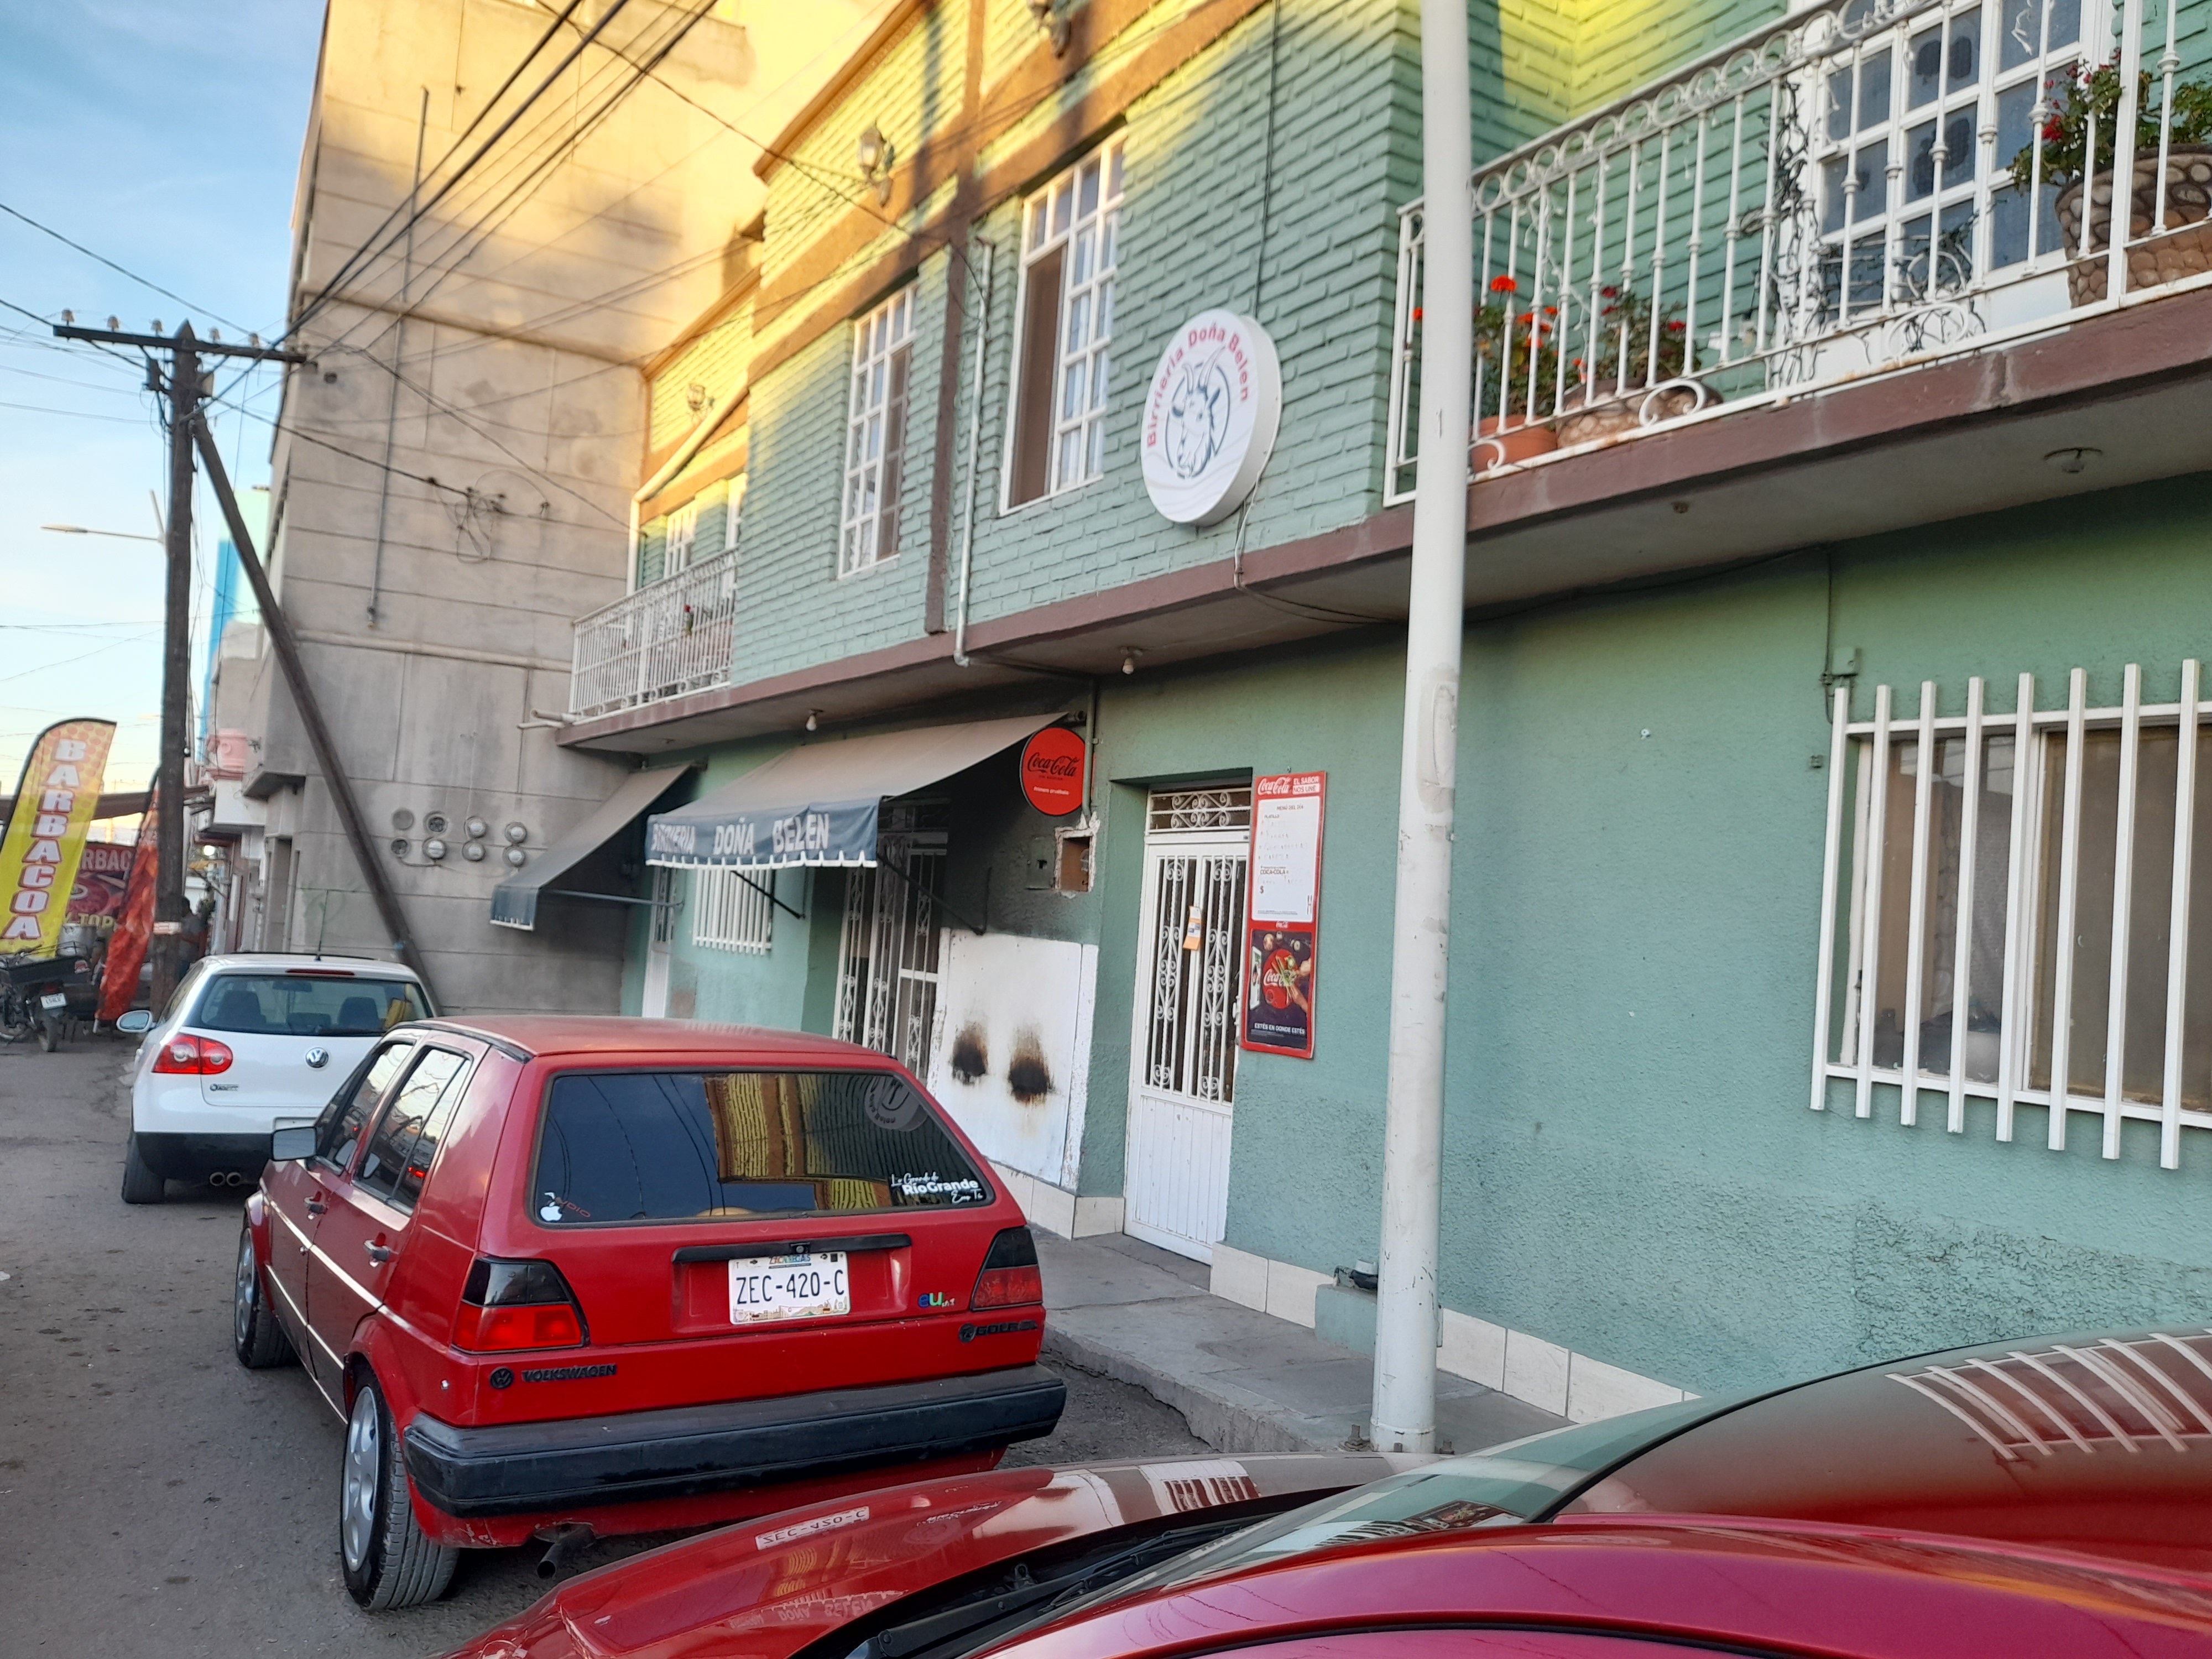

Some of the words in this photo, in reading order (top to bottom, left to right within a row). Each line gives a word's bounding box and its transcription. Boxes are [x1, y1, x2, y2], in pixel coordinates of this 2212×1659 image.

[1188, 321, 1226, 348] Doña
[1227, 334, 1250, 402] Belen
[1027, 752, 1080, 777] Coca-Cola
[1258, 776, 1291, 795] Coca-Cola
[0, 738, 87, 940] BARBACOA
[713, 816, 754, 855] DOÑA
[772, 813, 830, 854] BELEN
[82, 849, 132, 871] RBAC
[736, 1269, 844, 1305] ZEC-420-C
[521, 1363, 617, 1383] VOLKSWAGEN
